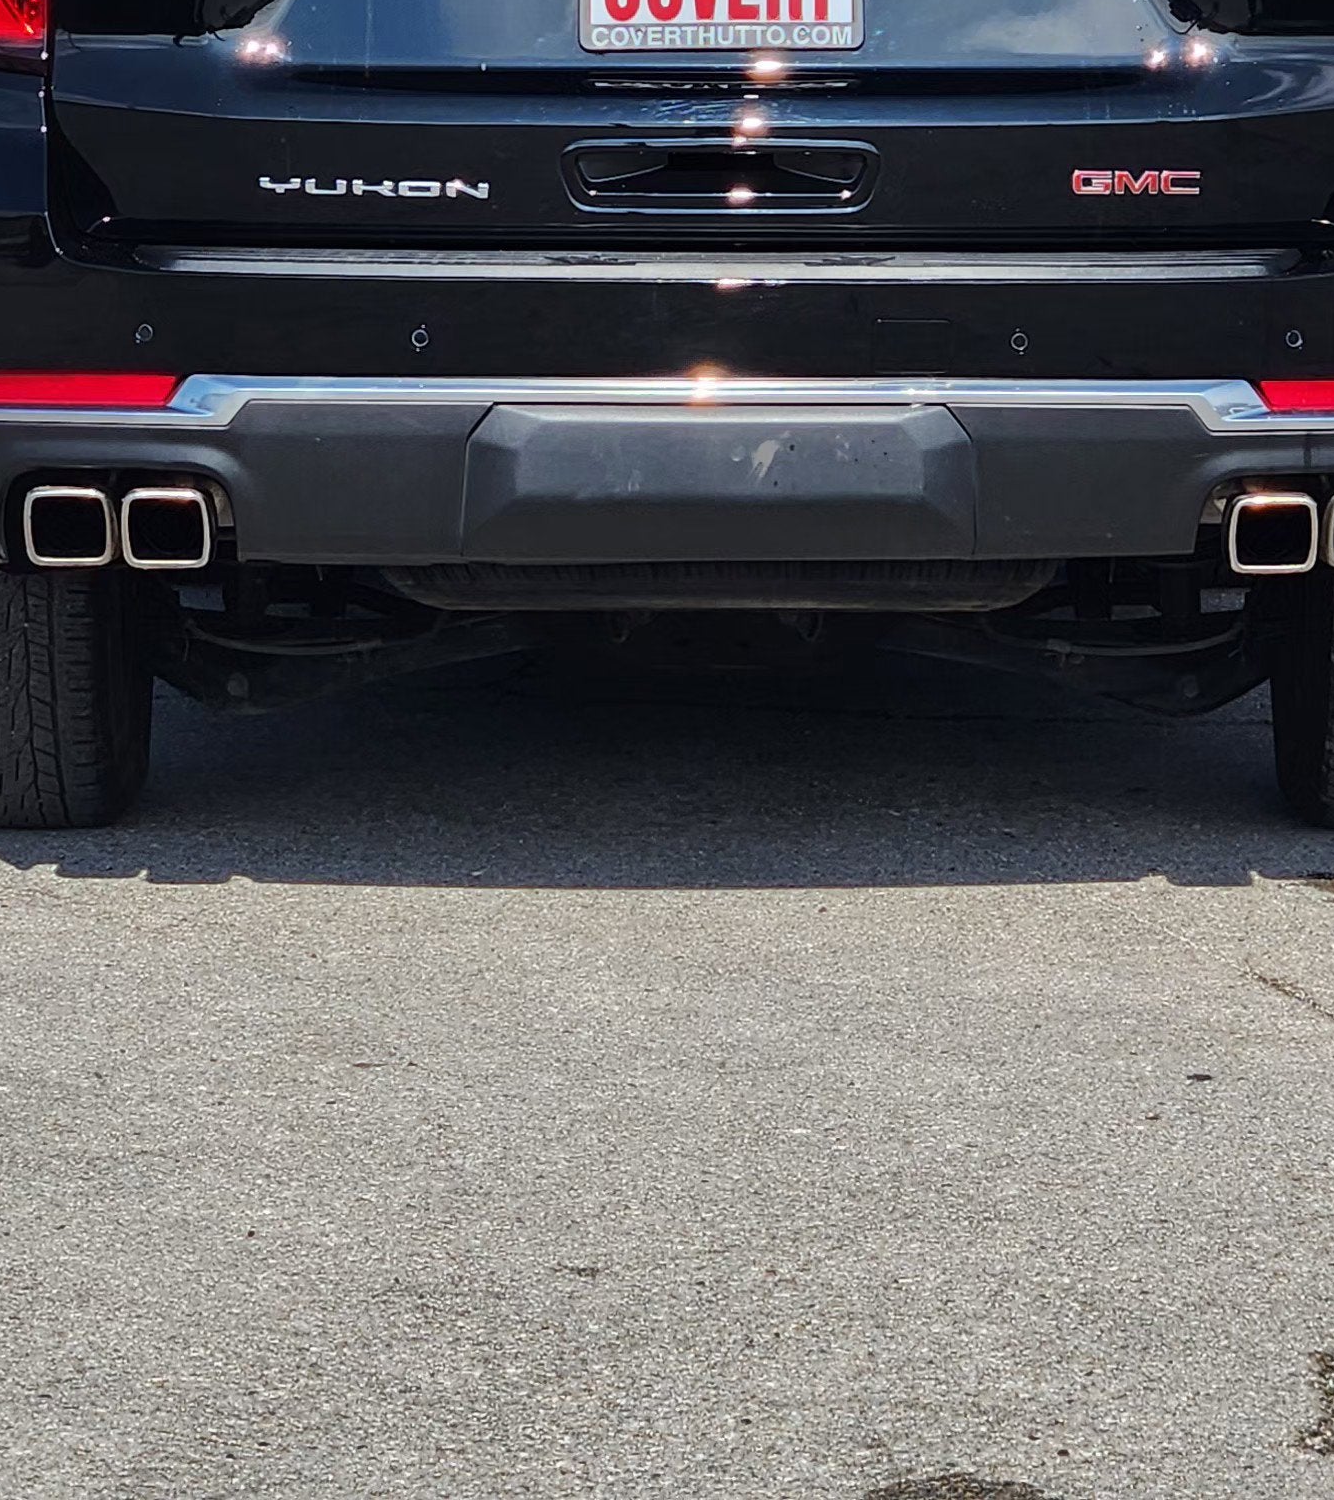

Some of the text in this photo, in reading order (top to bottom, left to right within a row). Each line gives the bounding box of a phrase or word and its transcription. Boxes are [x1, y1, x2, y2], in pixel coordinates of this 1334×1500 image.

[591, 26, 852, 47] COVERTHUTTO.COM
[259, 177, 489, 199] YUKON
[1072, 169, 1201, 195] GMC
